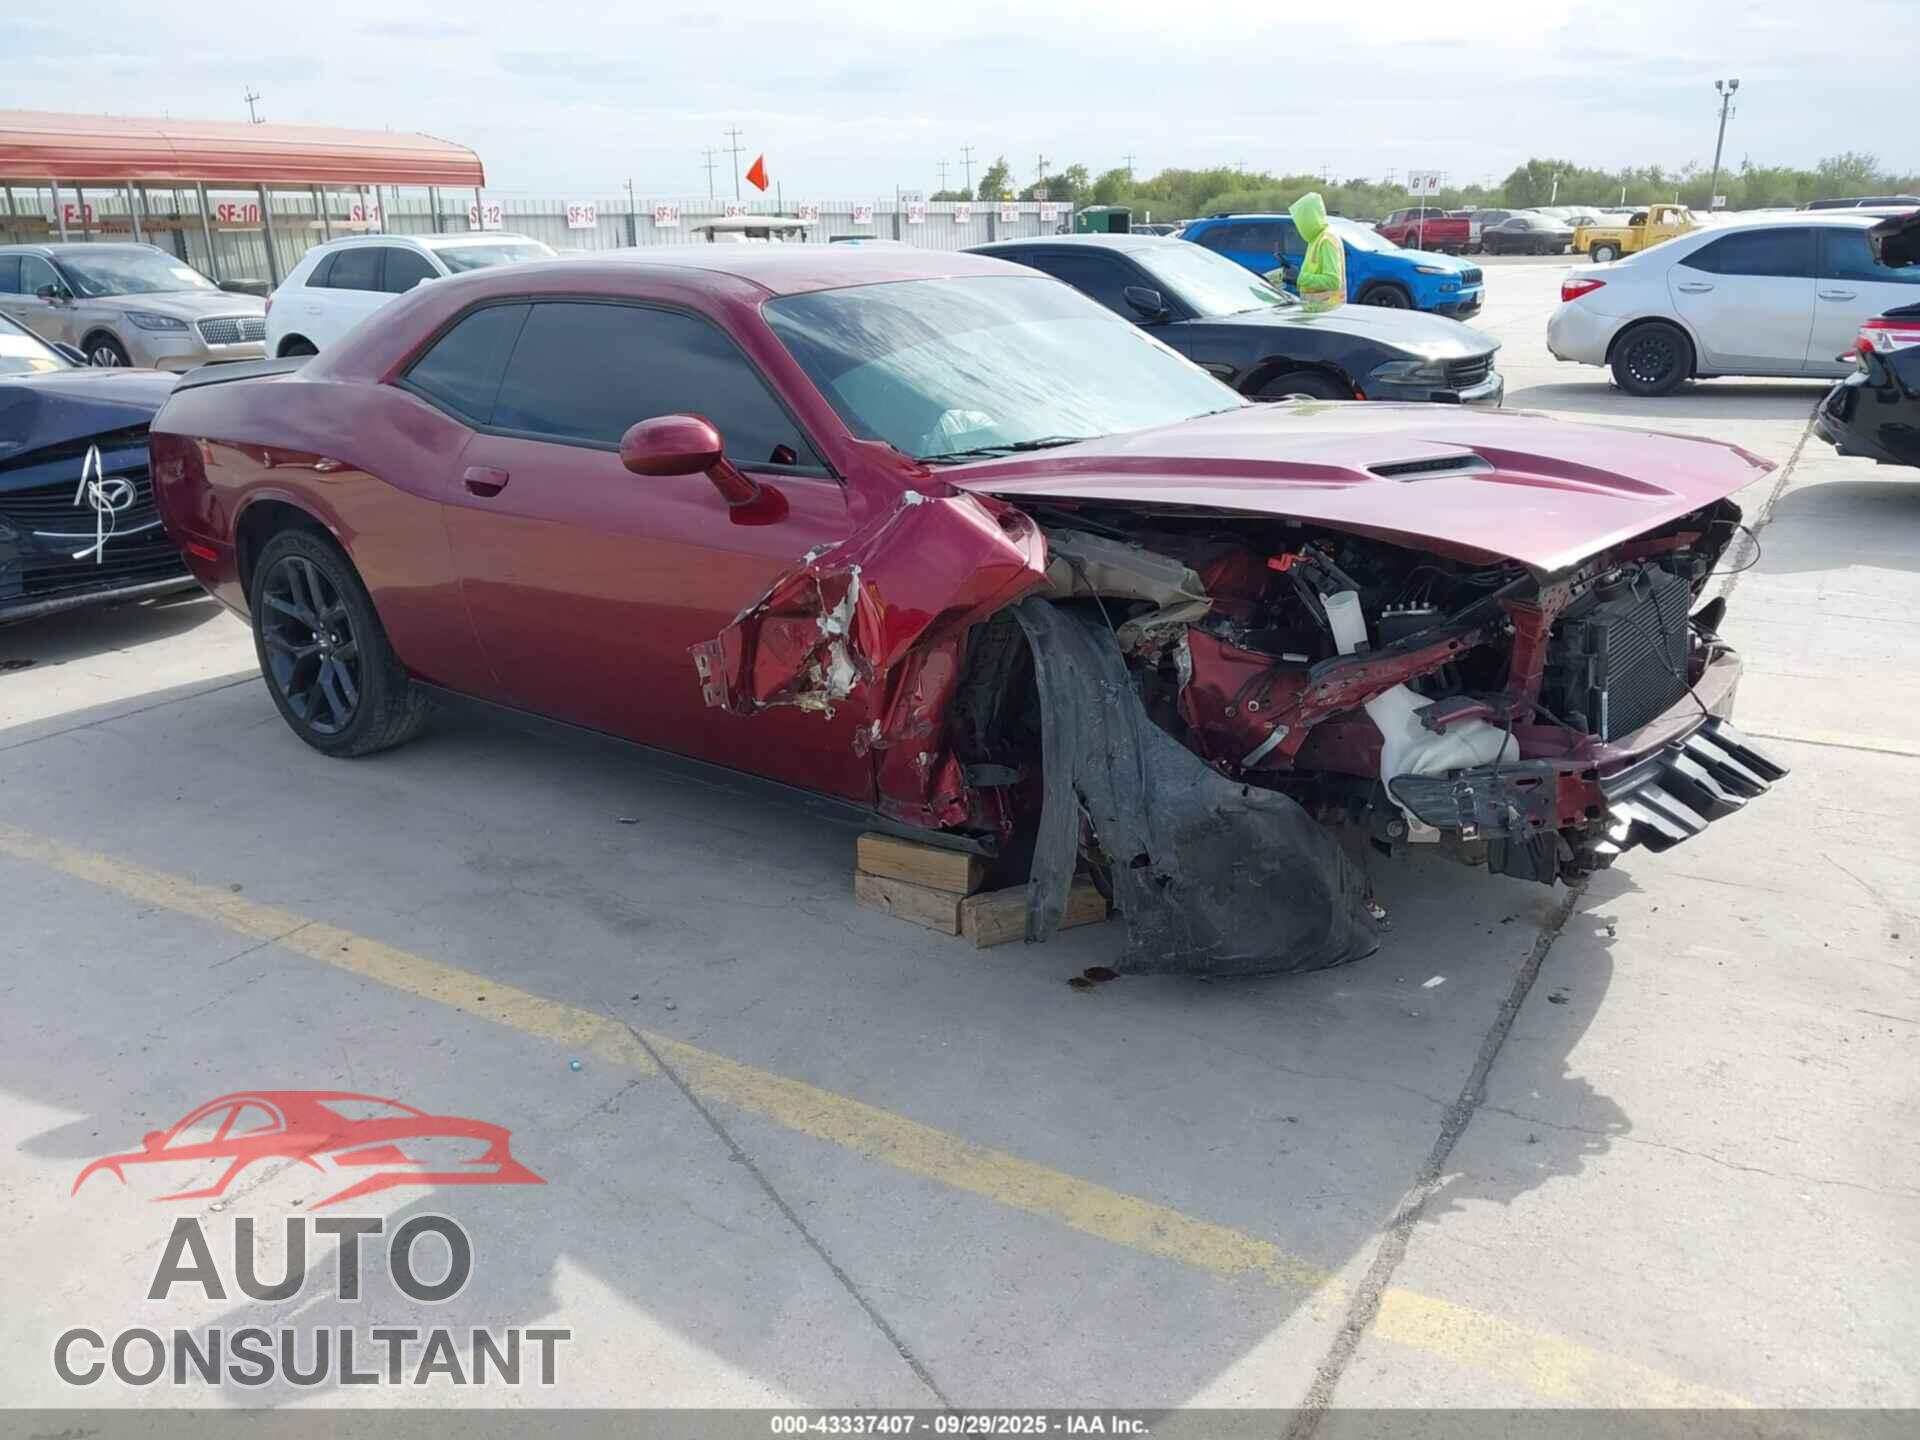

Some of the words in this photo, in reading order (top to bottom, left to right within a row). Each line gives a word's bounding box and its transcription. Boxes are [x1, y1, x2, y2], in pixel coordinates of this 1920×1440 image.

[1412, 177, 1421, 189] G
[1428, 176, 1438, 189] H
[568, 207, 594, 223] SF-13
[656, 207, 678, 222] SF-14
